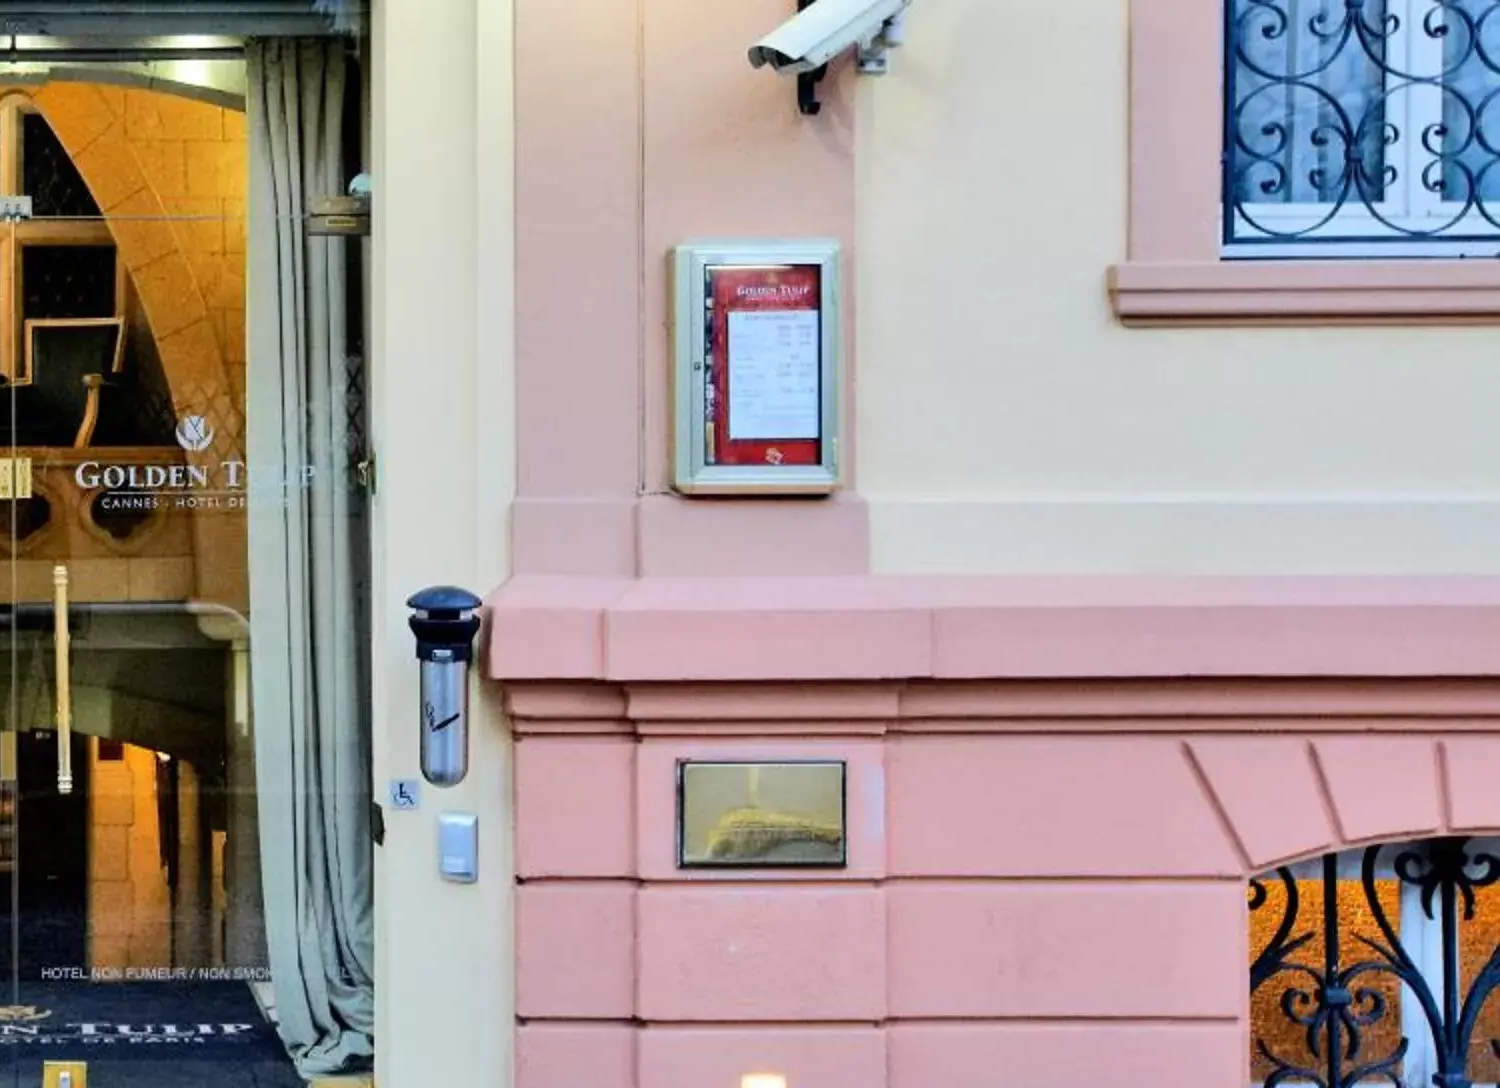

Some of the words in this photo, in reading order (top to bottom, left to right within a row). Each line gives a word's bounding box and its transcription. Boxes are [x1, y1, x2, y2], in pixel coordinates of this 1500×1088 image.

[75, 460, 208, 489] GOLDEN
[101, 499, 158, 510] CANNES
[175, 498, 220, 509] HOTEL
[41, 967, 87, 980] HOTEL
[91, 967, 121, 981] NON
[126, 967, 186, 980] FUMEUR
[200, 967, 230, 980] NON
[65, 1023, 252, 1036] TULIP
